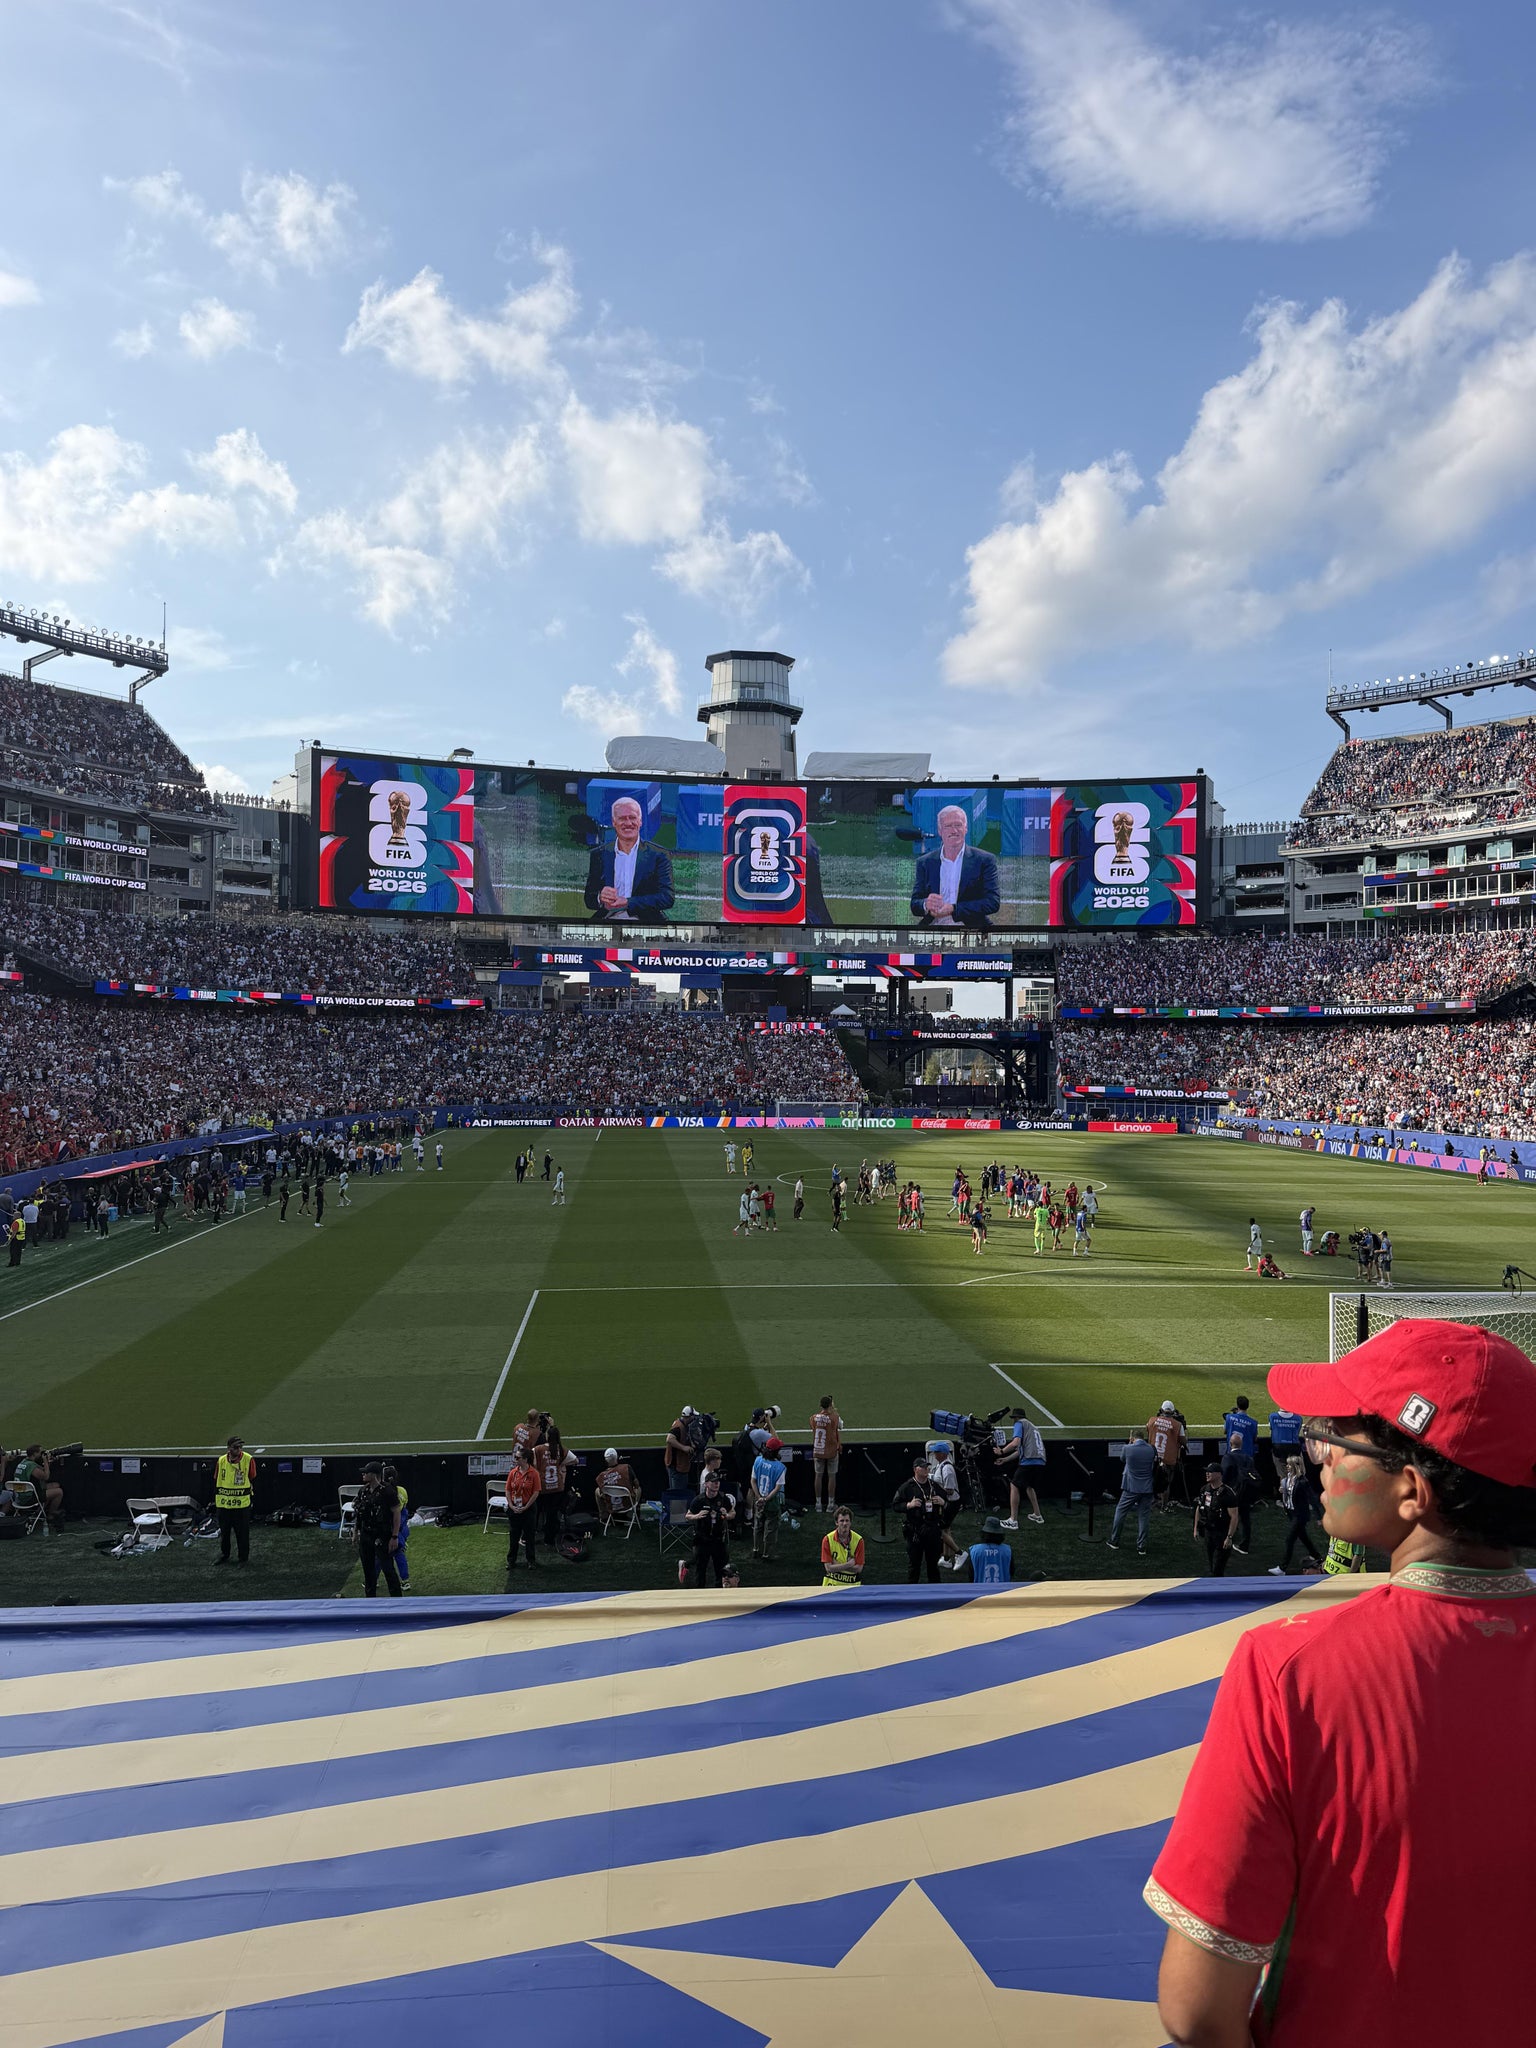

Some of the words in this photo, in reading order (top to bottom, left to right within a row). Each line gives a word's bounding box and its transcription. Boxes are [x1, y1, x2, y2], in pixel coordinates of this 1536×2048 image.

[698, 812, 724, 826] FIF
[1024, 816, 1050, 830] FIF
[65, 836, 82, 846] FIFA
[82, 840, 112, 850] WORLD
[112, 844, 128, 852] CUP
[386, 849, 412, 860] FIFA
[1500, 861, 1520, 870] FRANCE
[369, 868, 406, 879] WORLD
[407, 871, 428, 880] CUP
[1110, 868, 1135, 877] FIFA
[64, 872, 82, 882] FIFA
[82, 875, 110, 885] WORLD
[368, 878, 428, 894] 2026
[1094, 887, 1129, 896] WORLD
[1130, 887, 1150, 896] CUP
[1094, 896, 1150, 908] 2026
[1500, 896, 1520, 906] FRANCE
[554, 954, 582, 964] FRANCE
[638, 956, 662, 966] FIFA
[662, 957, 704, 967] WORLD
[705, 958, 728, 968] CUP
[729, 958, 768, 968] 2026
[838, 960, 866, 970] FRANCE
[956, 960, 1012, 972] #FIFAWorldCup
[198, 990, 216, 1000] FRANCE
[316, 996, 334, 1004] FIFA
[334, 997, 366, 1006] WORLD
[366, 998, 384, 1006] CUP
[384, 999, 415, 1007] 2026
[1342, 1006, 1370, 1014] WORLD
[1372, 1006, 1388, 1014] CUP
[1388, 1005, 1414, 1014] 2026
[1134, 1089, 1154, 1097] FIFA
[1154, 1090, 1184, 1098] WORLD
[1203, 1091, 1229, 1099] 2026
[472, 1119, 492, 1127] ADI
[559, 1118, 595, 1128] QATAR
[598, 1118, 643, 1127] AIRWAYS
[677, 1117, 704, 1128] VISA
[842, 1118, 896, 1128] aramco
[920, 1119, 948, 1129] Coca-Cola
[964, 1120, 991, 1129] Coca-Cola
[1034, 1122, 1072, 1130] HYUNDAI
[1114, 1122, 1152, 1132] Lenovo
[1196, 1126, 1210, 1136] ADI
[1210, 1129, 1244, 1140] PREDICTSTREET
[1258, 1132, 1278, 1145] QATAR
[1278, 1135, 1302, 1148] AIRWAYS
[1329, 1141, 1347, 1155] VISA
[1364, 1145, 1383, 1160] VISA
[984, 1548, 998, 1557] TPP
